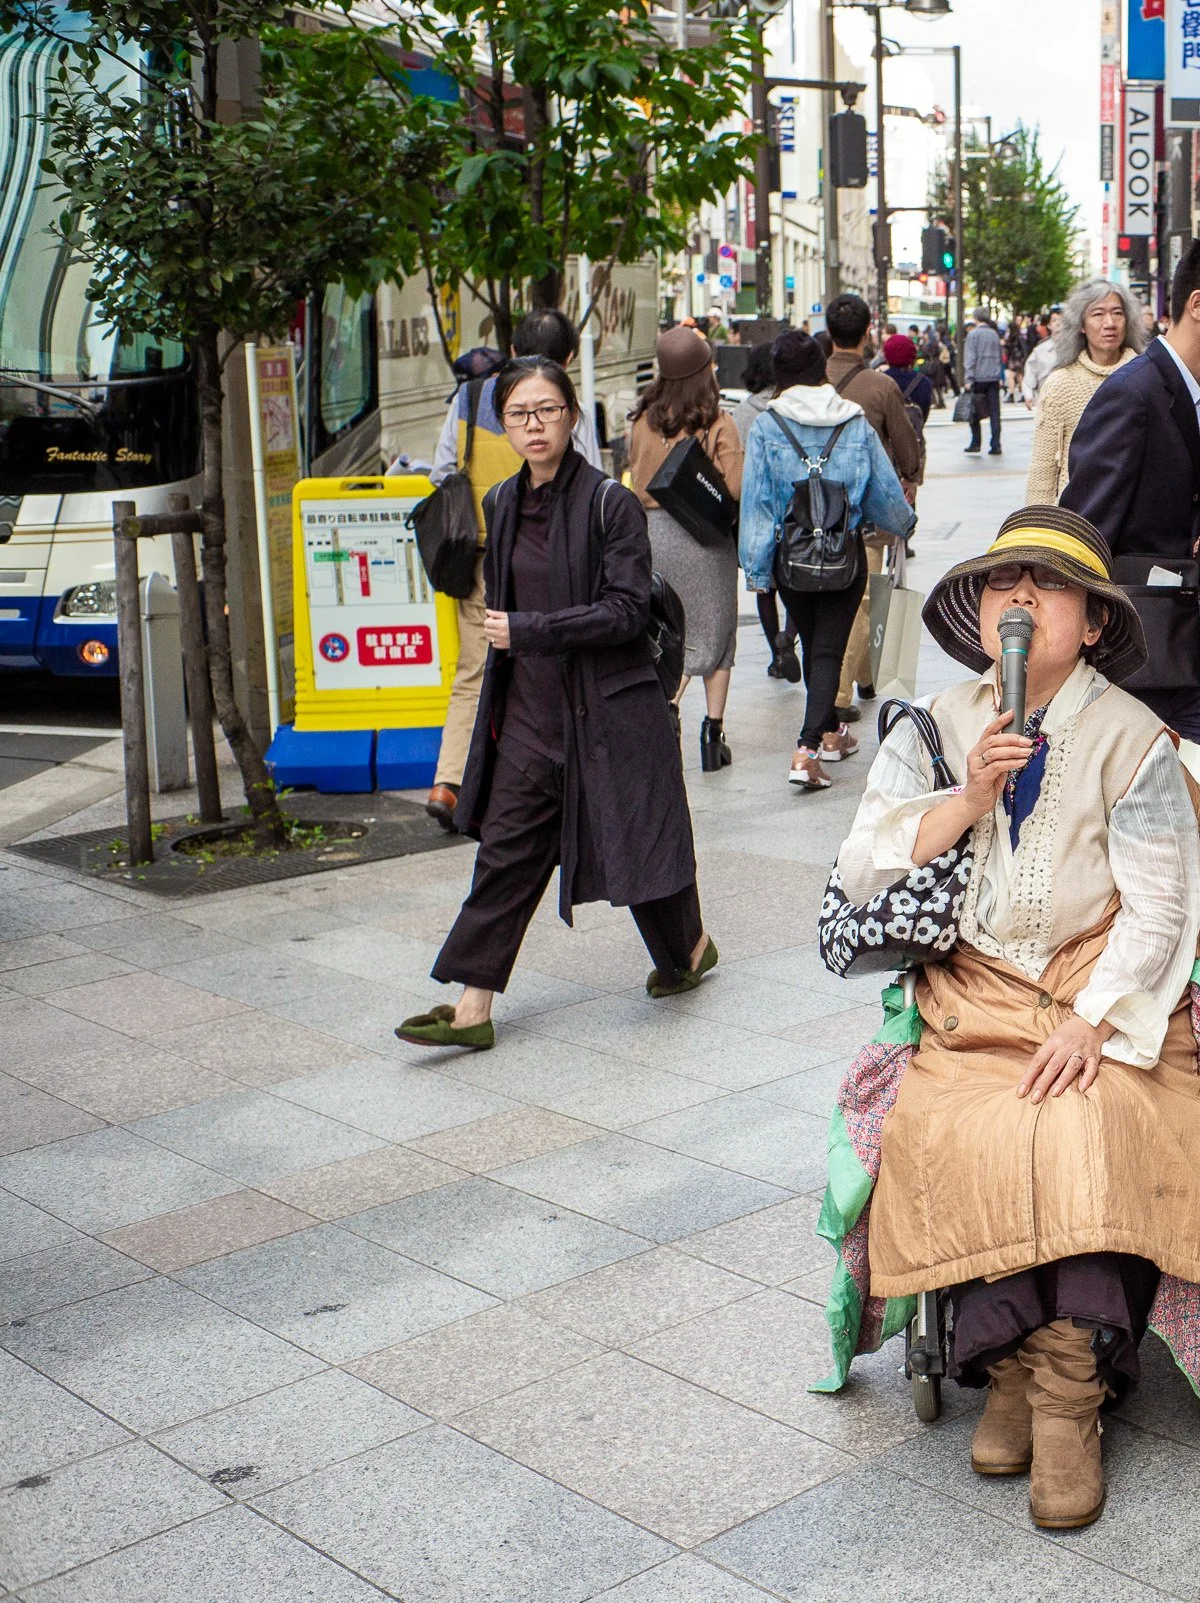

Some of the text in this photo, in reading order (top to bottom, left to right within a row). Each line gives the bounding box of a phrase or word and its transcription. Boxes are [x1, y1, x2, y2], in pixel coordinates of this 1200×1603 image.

[1129, 107, 1149, 217] ALOOK
[46, 446, 152, 464] Fantastic Story
[696, 472, 722, 503] EMODA
